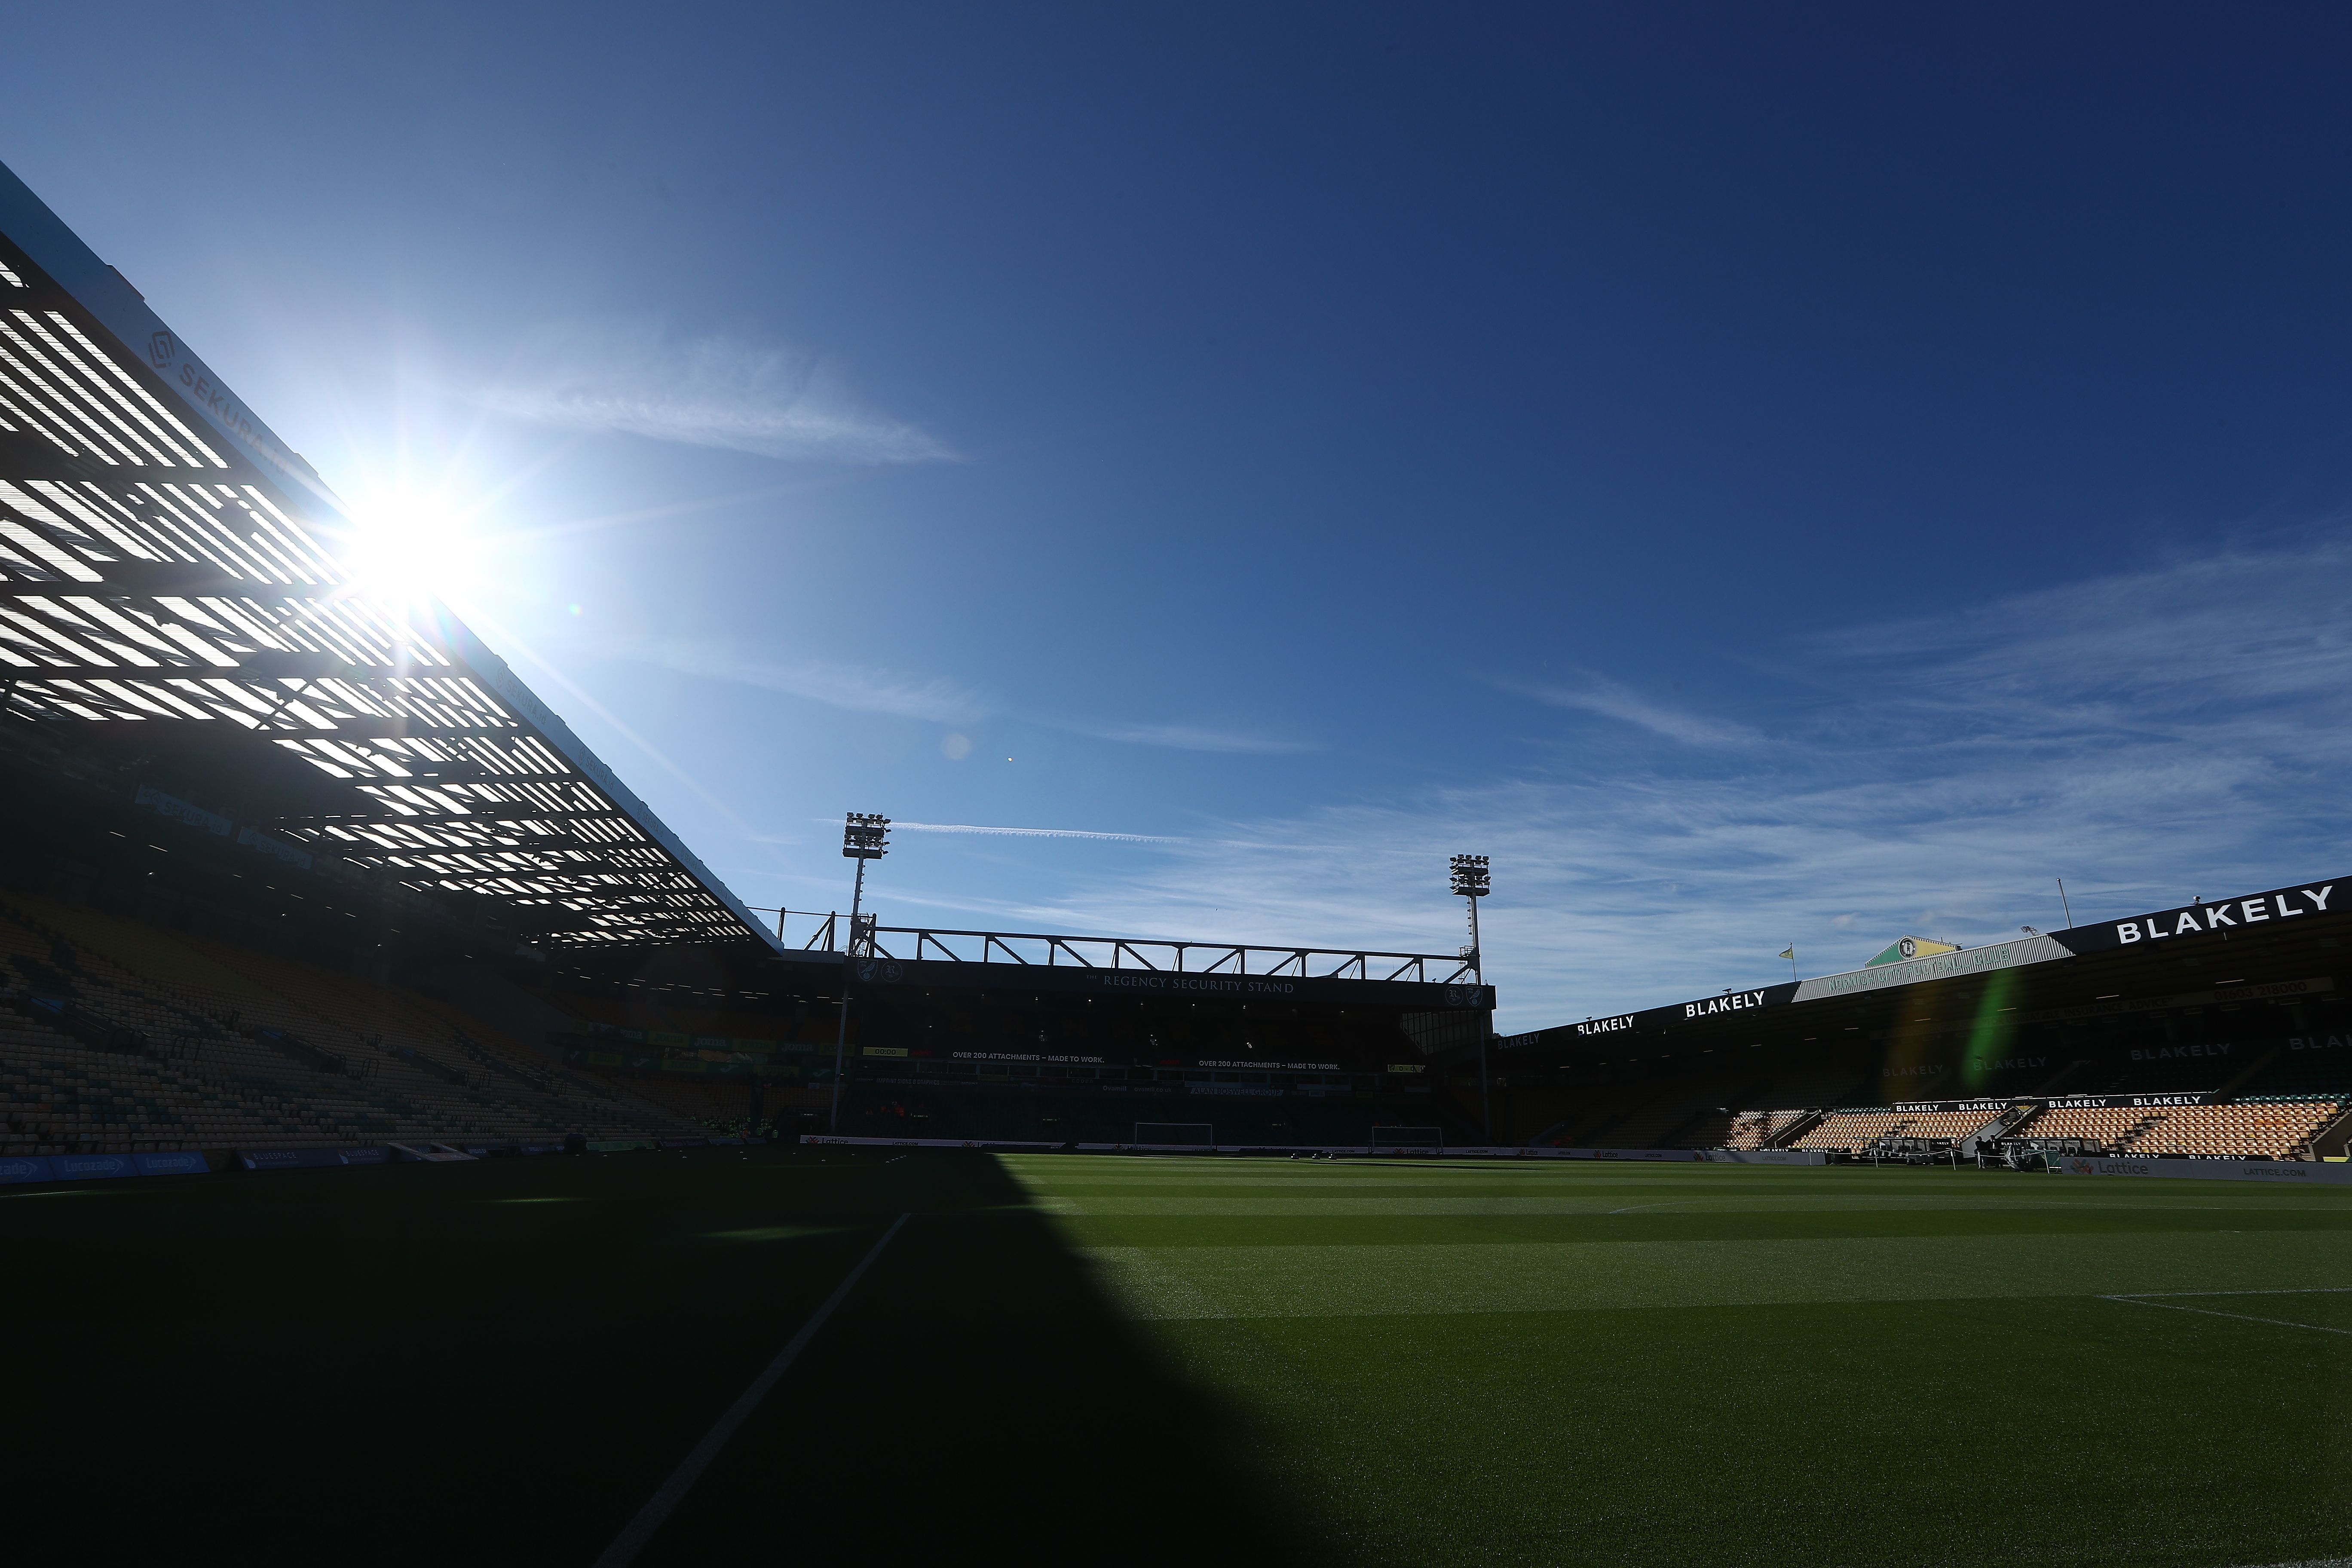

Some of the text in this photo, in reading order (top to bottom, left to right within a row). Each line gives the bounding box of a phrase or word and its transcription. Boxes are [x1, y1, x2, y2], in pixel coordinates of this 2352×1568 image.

[164, 801, 222, 833] SEKURAid
[2116, 884, 2333, 945] BLAKELY
[1828, 949, 2010, 991] NORWICH CITY FOOTBALL CLUB
[1104, 975, 1167, 987] REGENCY
[1173, 979, 1241, 991] SECURITY
[1248, 982, 1294, 993] STAND
[2214, 981, 2307, 1001] 01603 218000
[1685, 990, 1765, 1018] BLAKELY
[2064, 1002, 2123, 1017] INSURANCE
[1578, 1015, 1634, 1036] BLAKELY
[694, 1036, 726, 1047] joma
[781, 1041, 814, 1052] joma
[1498, 1032, 1540, 1050] BLAKELY
[988, 1053, 1040, 1061] ATTACHMENTS
[2131, 1043, 2230, 1060] BLAKELY
[1882, 1065, 1944, 1077] BLAKELY
[1974, 1056, 2046, 1071] BLAKELY
[1959, 1102, 2007, 1110] BLAKELY
[2049, 1099, 2107, 1108] BLAKELY
[2133, 1096, 2202, 1106] BLAKELY
[146, 1157, 190, 1168] Lucozade
[1705, 1153, 1726, 1161] Lattice
[64, 1160, 116, 1172] Lucozade
[2099, 1161, 2306, 1176] Lattice LATTICE.COM
